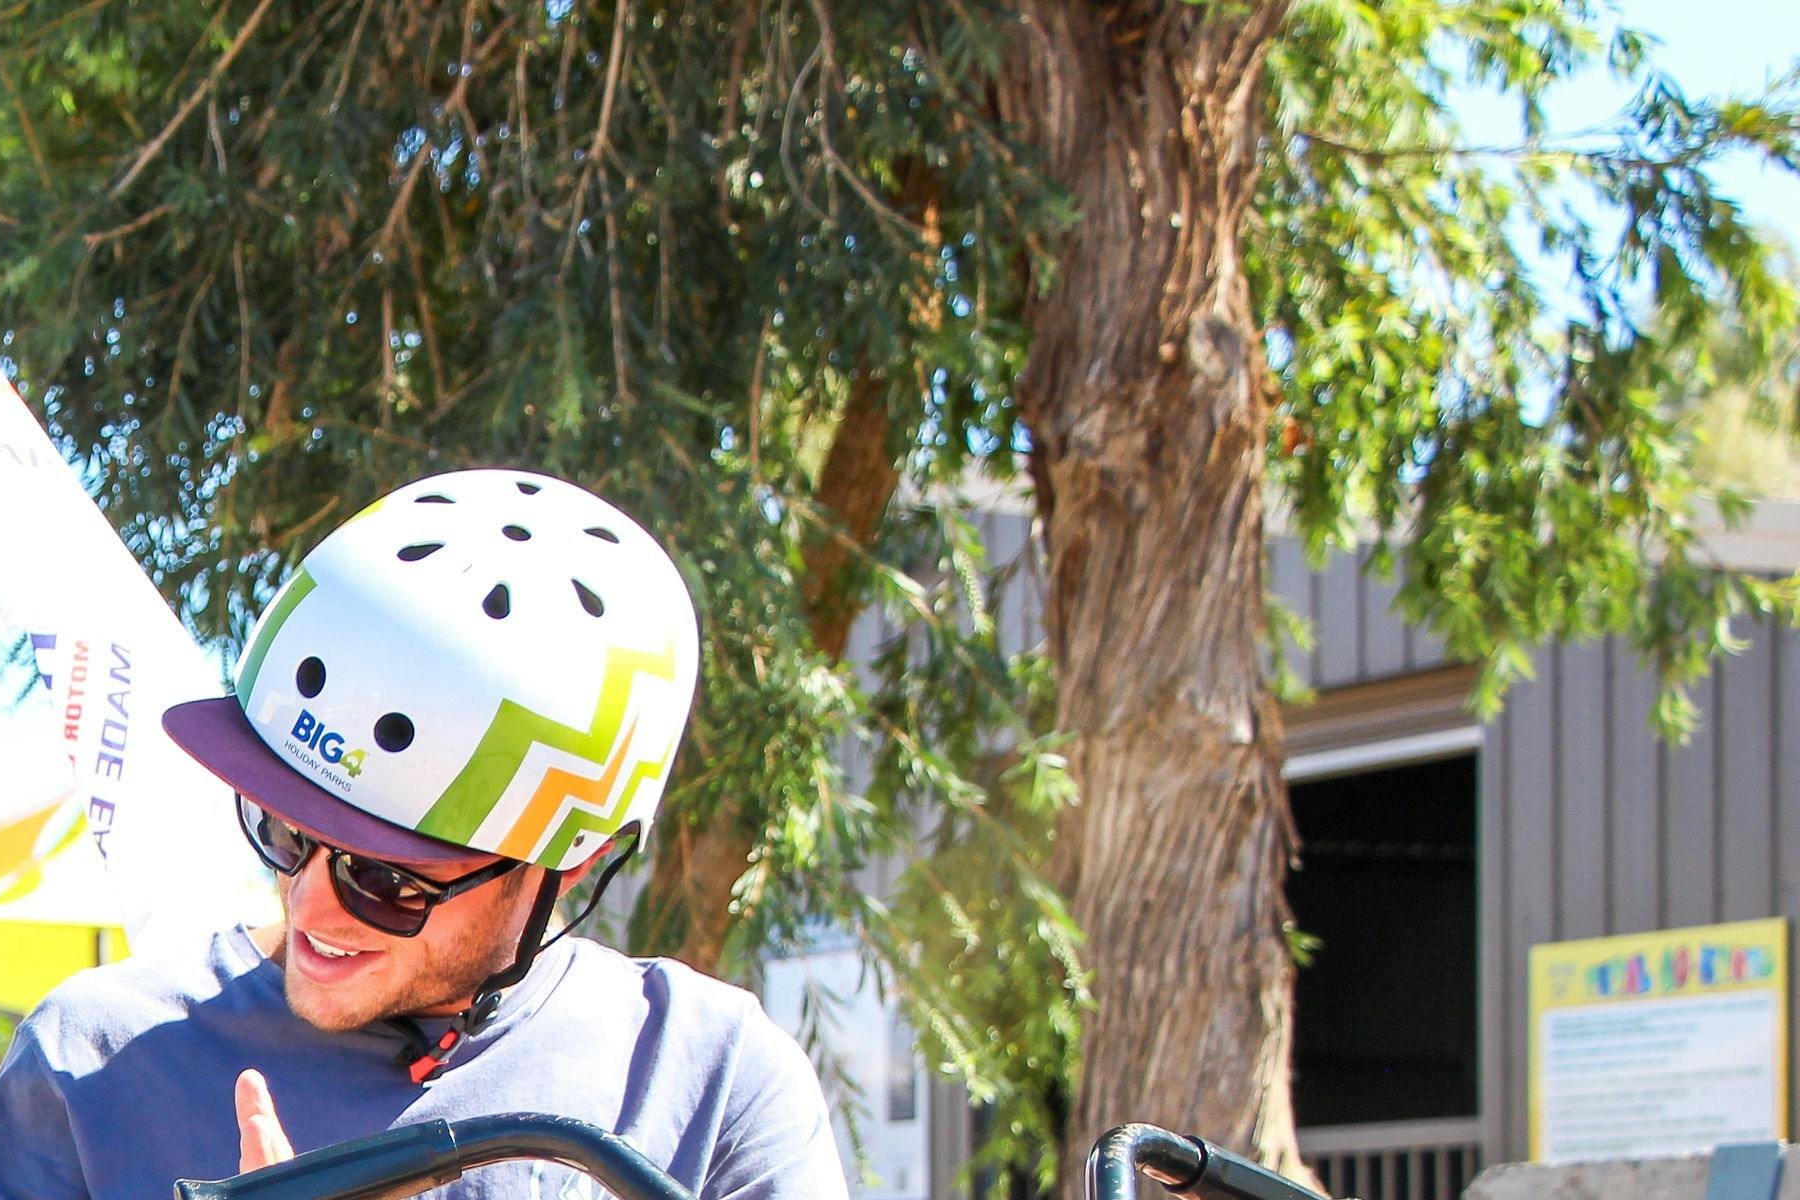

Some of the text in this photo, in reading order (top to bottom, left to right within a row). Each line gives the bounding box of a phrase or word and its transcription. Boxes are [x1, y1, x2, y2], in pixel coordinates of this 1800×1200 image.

[284, 740, 352, 792] HOLIDAY PARKS
[291, 708, 366, 778] BIG4
